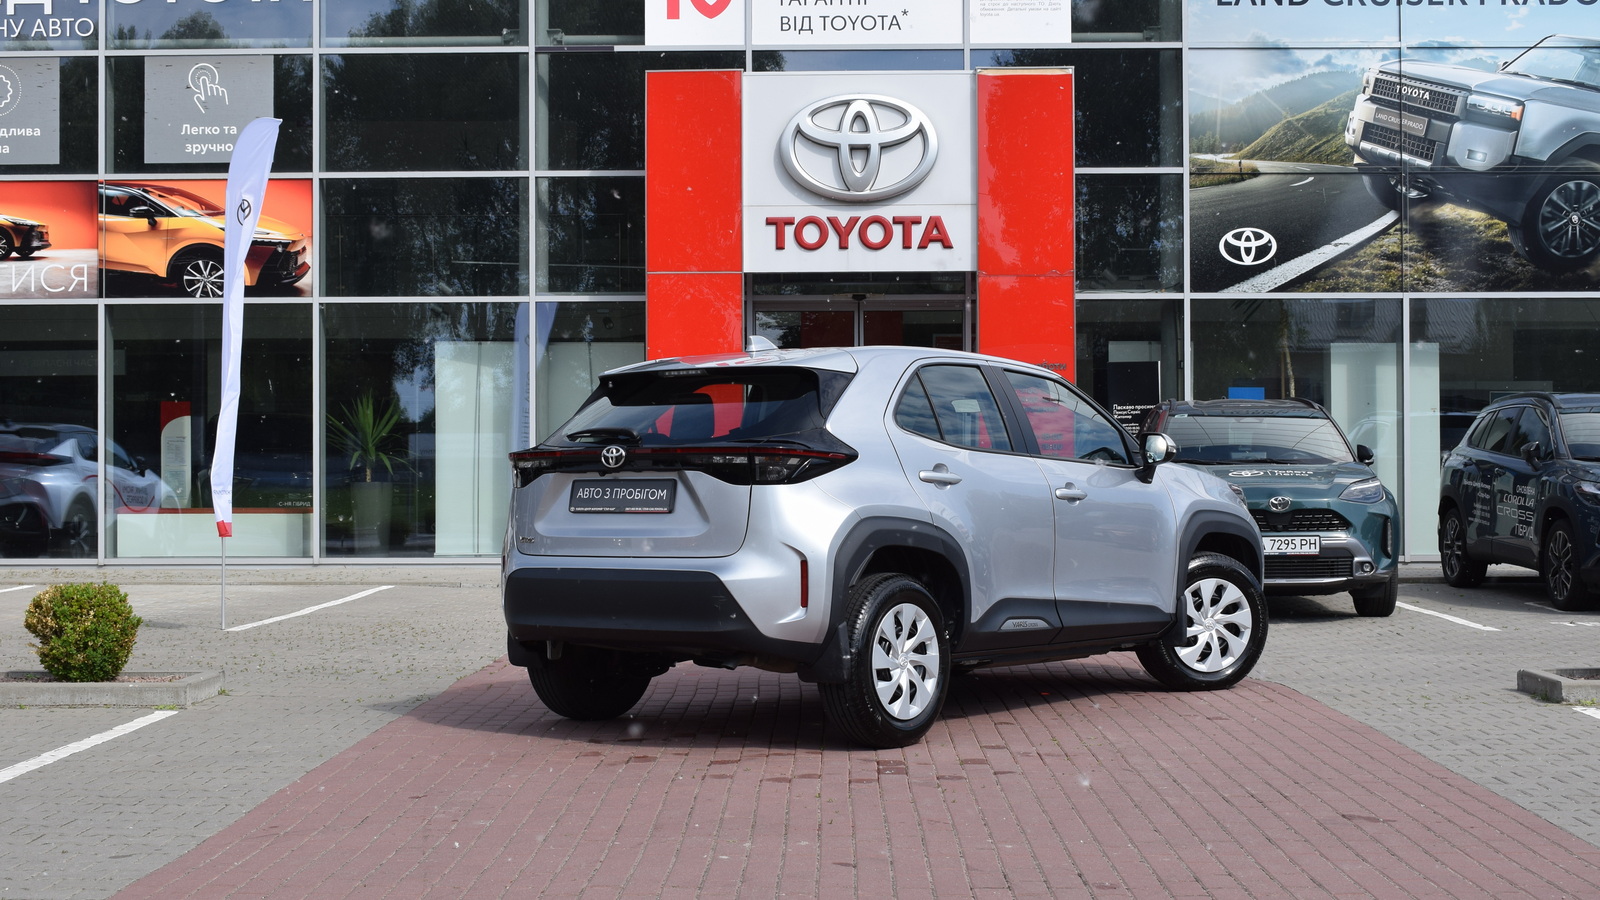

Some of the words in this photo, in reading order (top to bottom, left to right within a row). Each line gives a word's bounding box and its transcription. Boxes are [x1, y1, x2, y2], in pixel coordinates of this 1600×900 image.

[31, 17, 94, 37] АВТО
[780, 15, 813, 35] ВІД
[1396, 85, 1430, 100] TOYOTA
[1375, 112, 1388, 120] LAND
[181, 124, 220, 135] Легко
[223, 126, 237, 135] та
[185, 143, 234, 155] зручно
[765, 215, 954, 250] TOYOTA
[576, 488, 602, 499] АВТО
[613, 488, 667, 500] ПРОБІГОМ
[1503, 494, 1534, 508] COROLLA
[1496, 505, 1534, 522] CROSS
[1269, 538, 1297, 551] 7295
